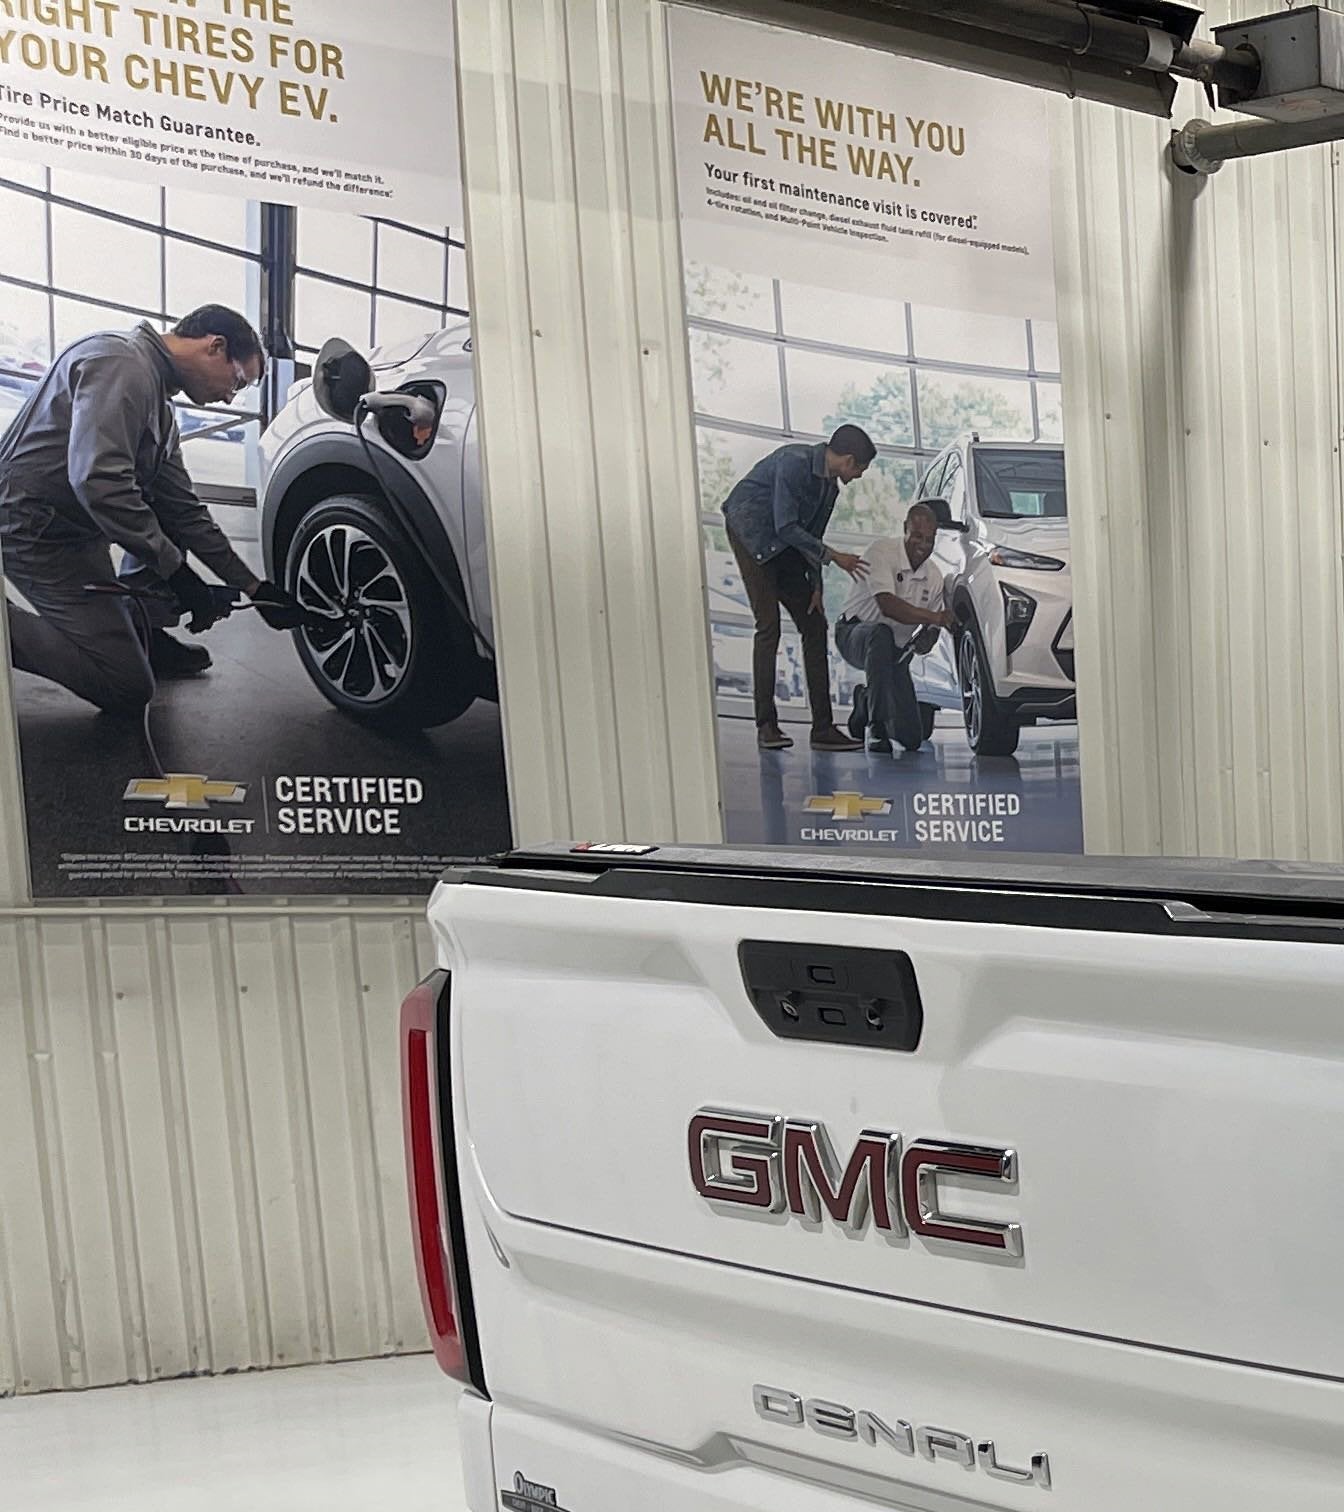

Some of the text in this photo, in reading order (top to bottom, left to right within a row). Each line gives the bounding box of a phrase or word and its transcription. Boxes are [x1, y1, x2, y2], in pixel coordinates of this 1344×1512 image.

[133, 8, 254, 63] TIRES
[269, 33, 345, 80] FOR
[0, 29, 338, 123] YOUR CHEVY EV.
[39, 92, 90, 117] Price
[96, 103, 155, 129] Match
[160, 115, 261, 147] Guarantee.
[700, 70, 965, 156] WE'RE WITH YOU
[32, 132, 64, 145] better
[67, 140, 93, 153] price
[95, 144, 127, 157] within
[130, 150, 142, 160] 30
[145, 152, 167, 166] days
[170, 156, 180, 166] of
[182, 159, 198, 169] the
[201, 162, 248, 178] purchase,
[250, 170, 266, 180] and
[269, 173, 291, 183] we'll
[292, 176, 323, 188] refund
[326, 181, 341, 191] the
[39, 121, 50, 131] us
[53, 124, 76, 135] with
[79, 129, 85, 137] a
[87, 129, 119, 143] better
[122, 135, 157, 151] eligible
[160, 142, 185, 155] price
[187, 147, 198, 157] at
[200, 148, 215, 160] the
[218, 152, 239, 164] time
[242, 155, 252, 165] of
[254, 158, 300, 173] purchase,
[302, 165, 318, 175] and
[321, 168, 342, 178] we'll
[344, 172, 373, 183] match
[375, 175, 385, 185] it.
[703, 113, 921, 188] ALL THE WAY.
[704, 161, 739, 184] Your
[742, 170, 775, 192] first
[779, 180, 869, 211] maintenance
[873, 199, 902, 218] visit
[905, 204, 917, 220] is
[275, 775, 424, 805] CERTIFIED
[912, 793, 1020, 816] CERTIFIED
[123, 816, 256, 834] CHEVROLET
[277, 806, 401, 834] SERVICE
[801, 827, 898, 842] CHEVROLET
[915, 820, 1004, 842] SERVICE
[688, 1105, 1023, 1258] GMC
[752, 1383, 1052, 1490] DENALI
